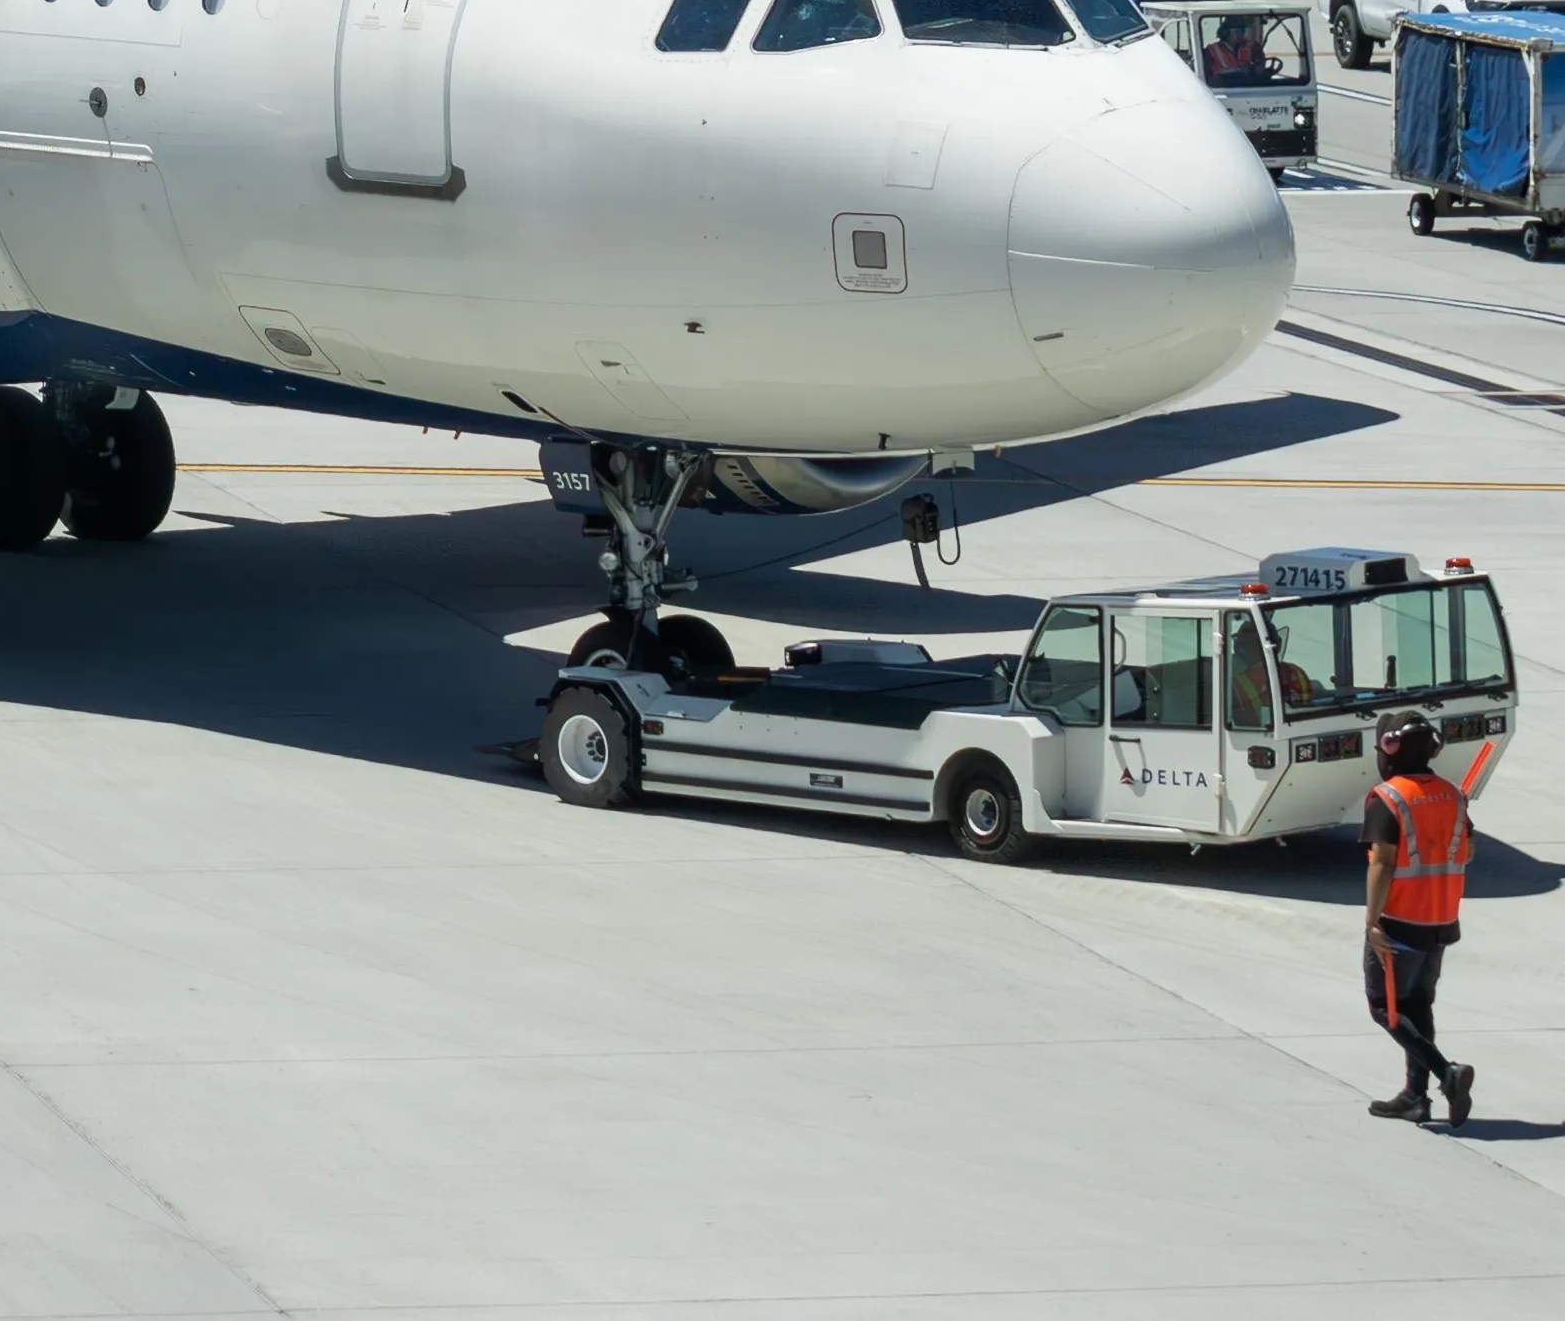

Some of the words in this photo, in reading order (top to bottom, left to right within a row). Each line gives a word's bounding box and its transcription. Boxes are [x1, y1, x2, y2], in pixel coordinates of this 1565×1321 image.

[552, 471, 590, 491] 3157
[1274, 565, 1346, 591] 271415
[1141, 768, 1208, 788] DELTA
